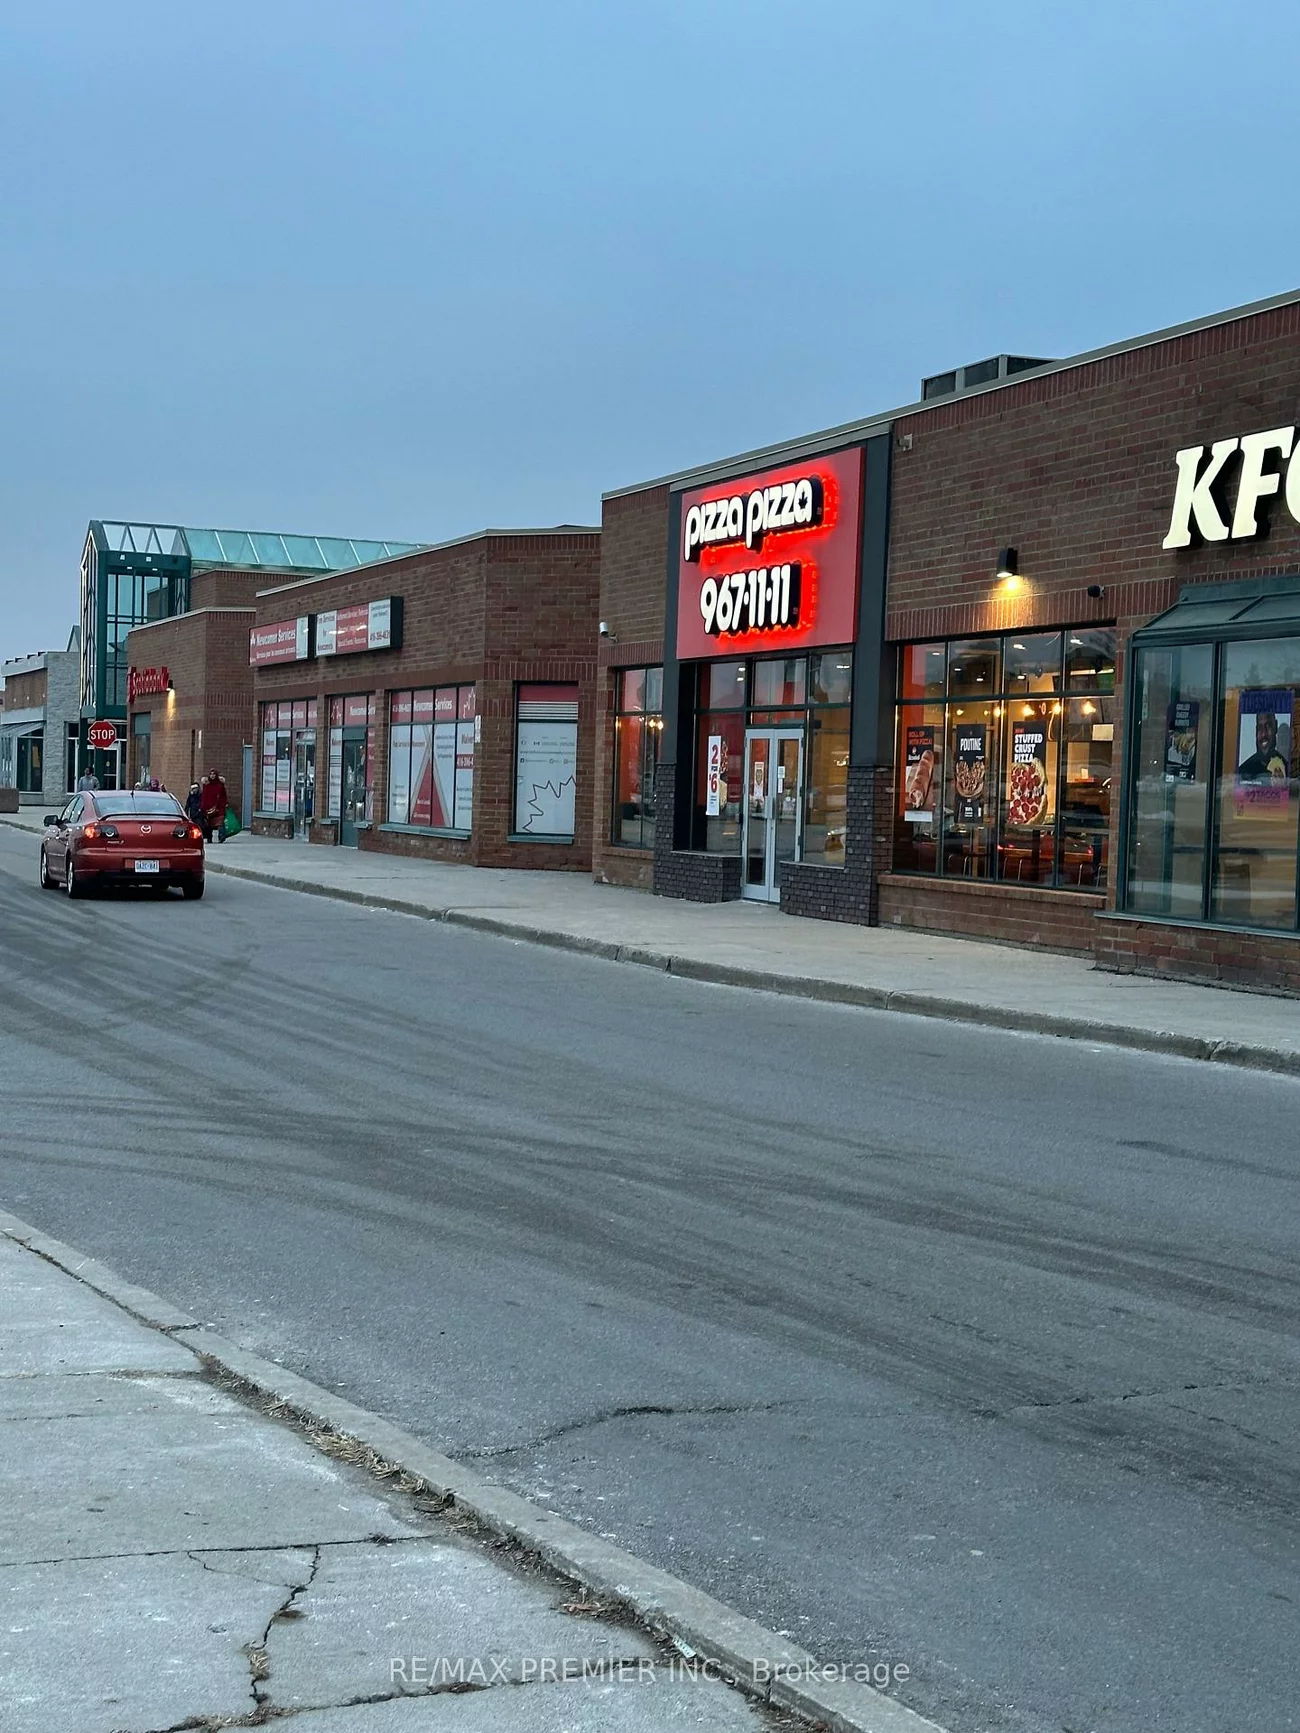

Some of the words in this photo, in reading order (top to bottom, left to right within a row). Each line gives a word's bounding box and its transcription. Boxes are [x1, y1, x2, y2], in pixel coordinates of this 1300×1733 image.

[684, 495, 744, 561] pizza
[746, 478, 813, 549] pizza
[278, 627, 296, 643] Services
[434, 697, 453, 710] Services
[90, 729, 115, 740] STOP
[1014, 733, 1043, 744] STUFFED
[960, 738, 982, 751] POUTINE
[1014, 744, 1036, 754] CRUST
[711, 744, 719, 765] 2
[1014, 753, 1034, 763] PIZZA
